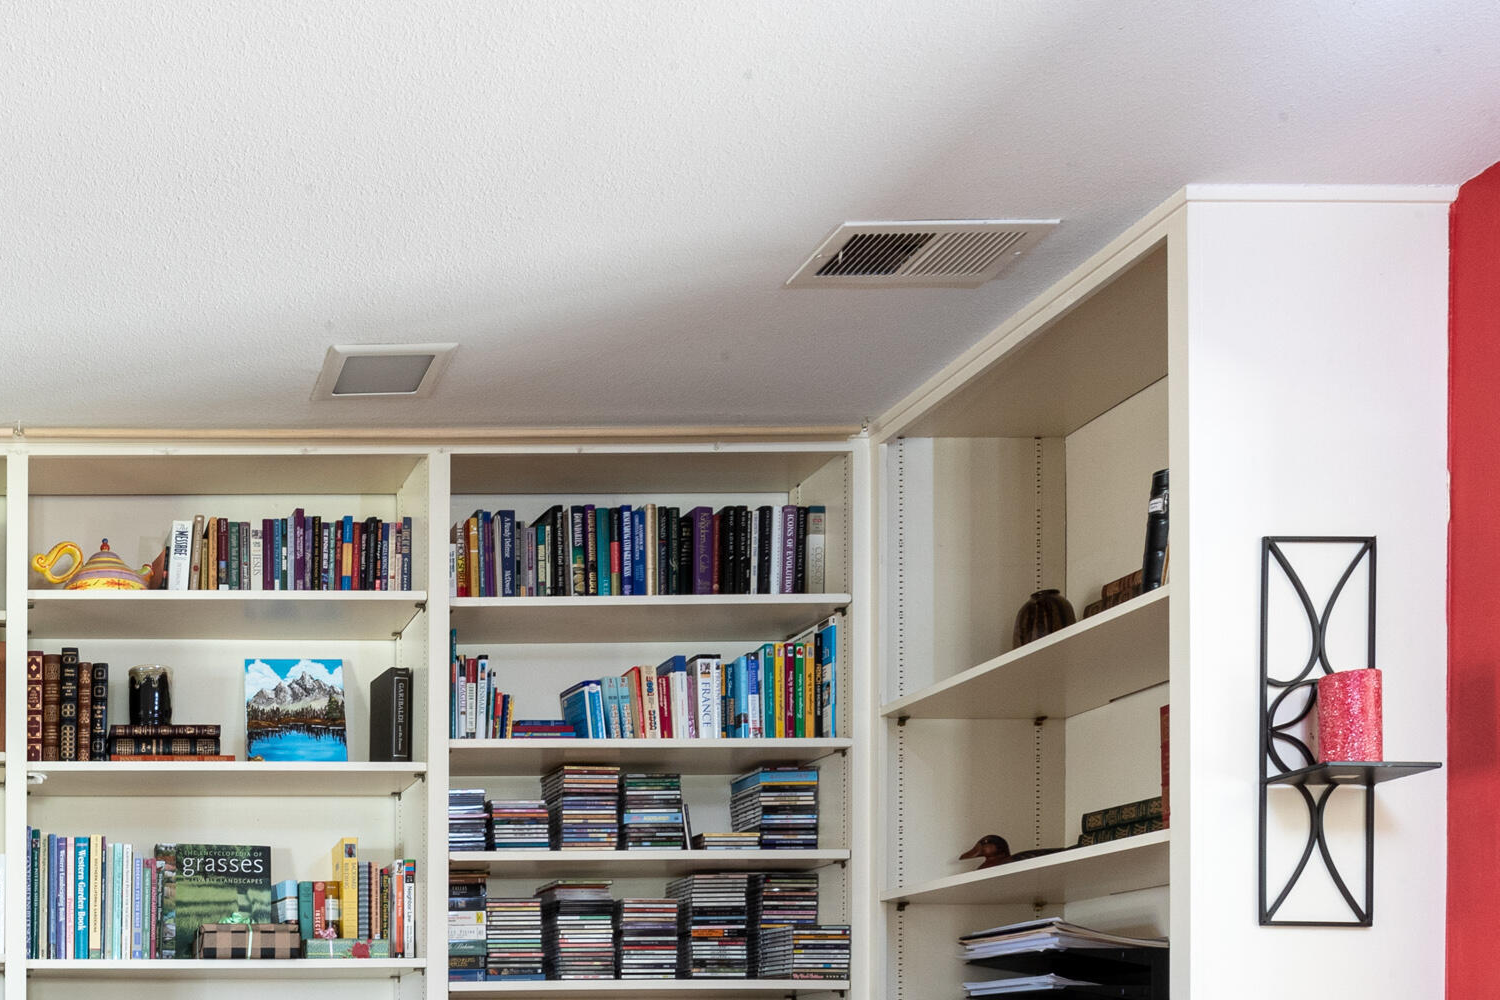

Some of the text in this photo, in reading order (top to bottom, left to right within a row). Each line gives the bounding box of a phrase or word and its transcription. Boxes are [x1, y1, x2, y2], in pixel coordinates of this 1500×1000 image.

[503, 522, 511, 538] Ready
[573, 513, 583, 547] BOUNDARIES
[623, 511, 631, 540] DESCENDING
[698, 513, 710, 543] Kingdom
[174, 530, 188, 556] MESSAGE
[787, 538, 794, 548] OF
[252, 554, 261, 576] JESUS
[785, 551, 793, 593] EVOLUTION
[701, 681, 712, 728] FRANCE
[58, 849, 66, 872] Western
[183, 857, 263, 877] grasses
[77, 849, 87, 931] Western Garden Book
